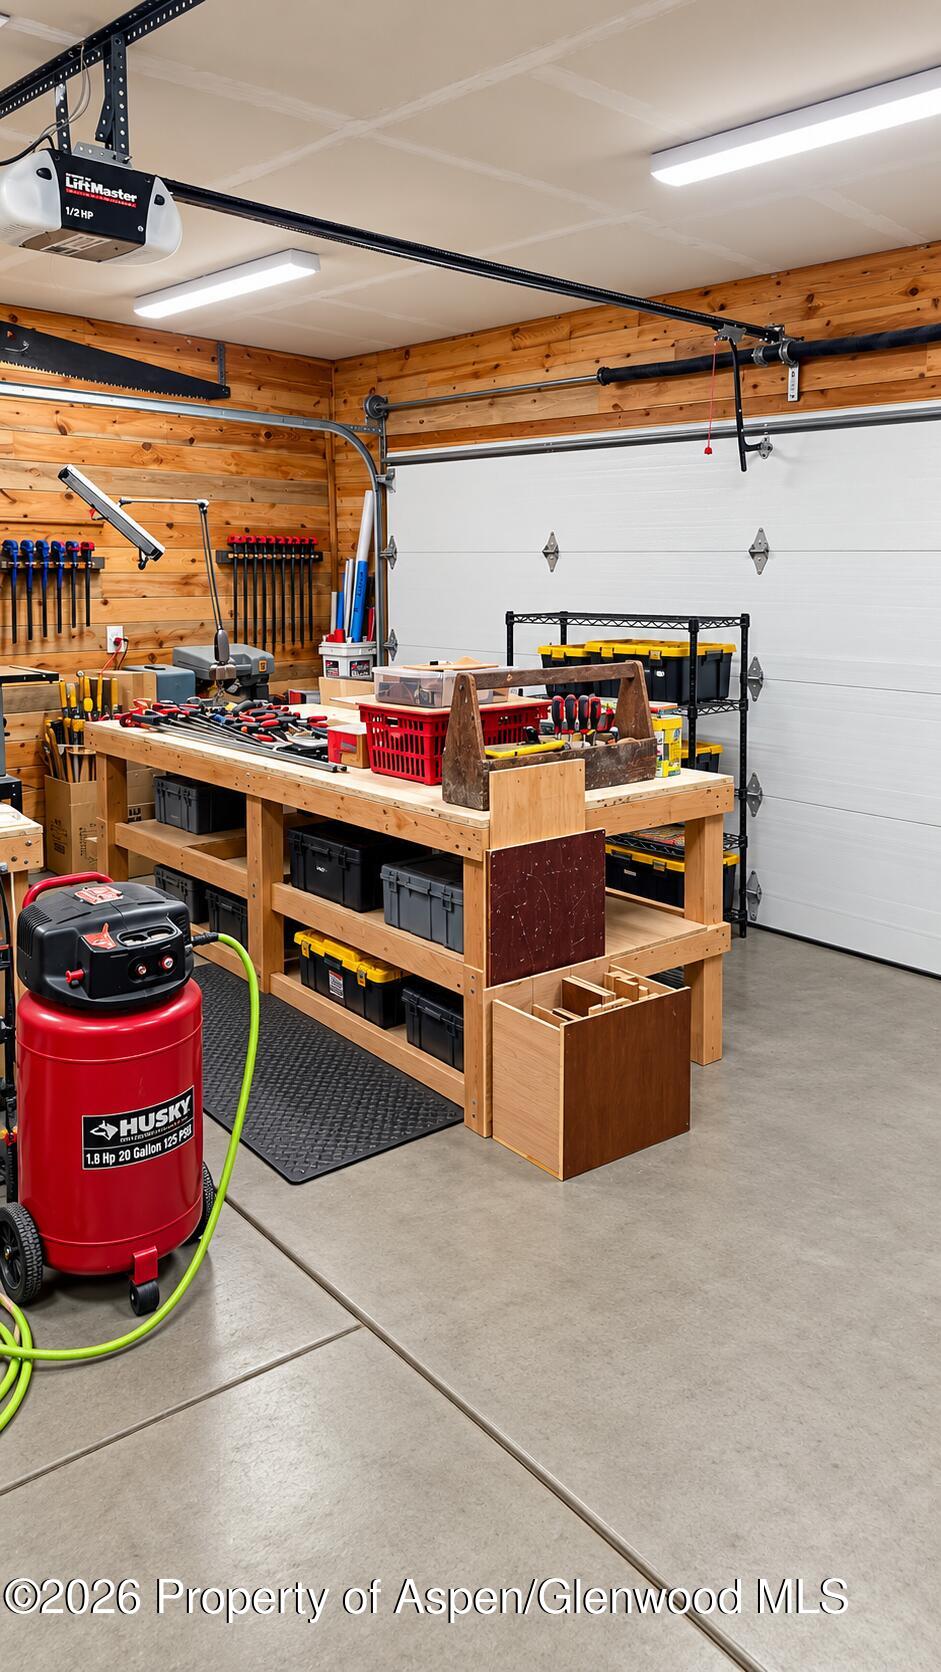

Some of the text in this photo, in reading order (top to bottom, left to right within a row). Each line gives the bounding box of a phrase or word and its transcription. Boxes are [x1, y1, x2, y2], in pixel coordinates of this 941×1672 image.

[65, 176, 138, 203] LiftMaster
[65, 206, 94, 220] 1/2 HP
[120, 1094, 191, 1137] HUSKY
[86, 1153, 100, 1165] 1.8
[102, 1152, 116, 1166] Hp
[118, 1149, 131, 1162] 20
[133, 1141, 162, 1159] Gallon
[163, 1134, 178, 1149] 125
